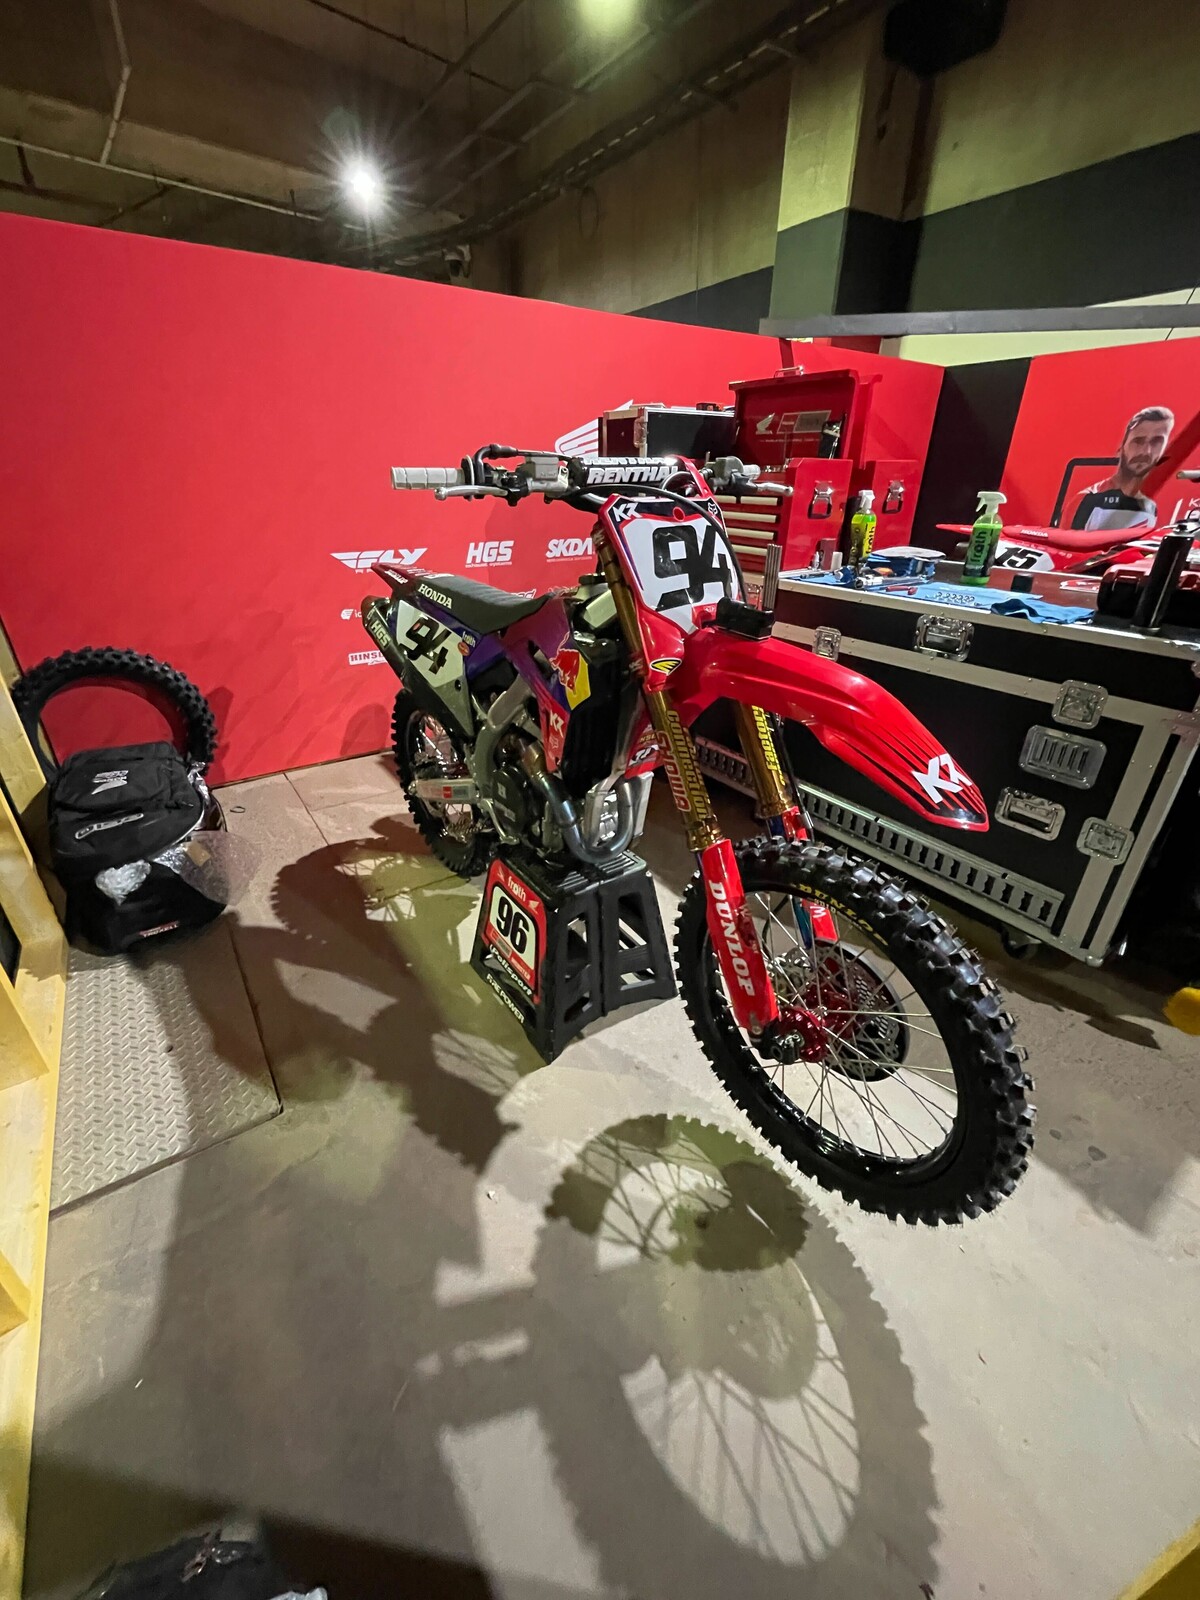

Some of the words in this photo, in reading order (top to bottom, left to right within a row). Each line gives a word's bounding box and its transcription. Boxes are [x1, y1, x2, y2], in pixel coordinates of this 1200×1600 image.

[330, 548, 428, 569] FLY
[466, 540, 514, 564] HGS
[993, 546, 1044, 570] 15
[652, 525, 733, 611] 94
[418, 584, 452, 609] HONDA
[370, 620, 391, 649] HGS
[399, 616, 452, 675] 94
[350, 652, 388, 662] HINS
[496, 896, 529, 954] 96
[708, 880, 755, 997] DUNLOP
